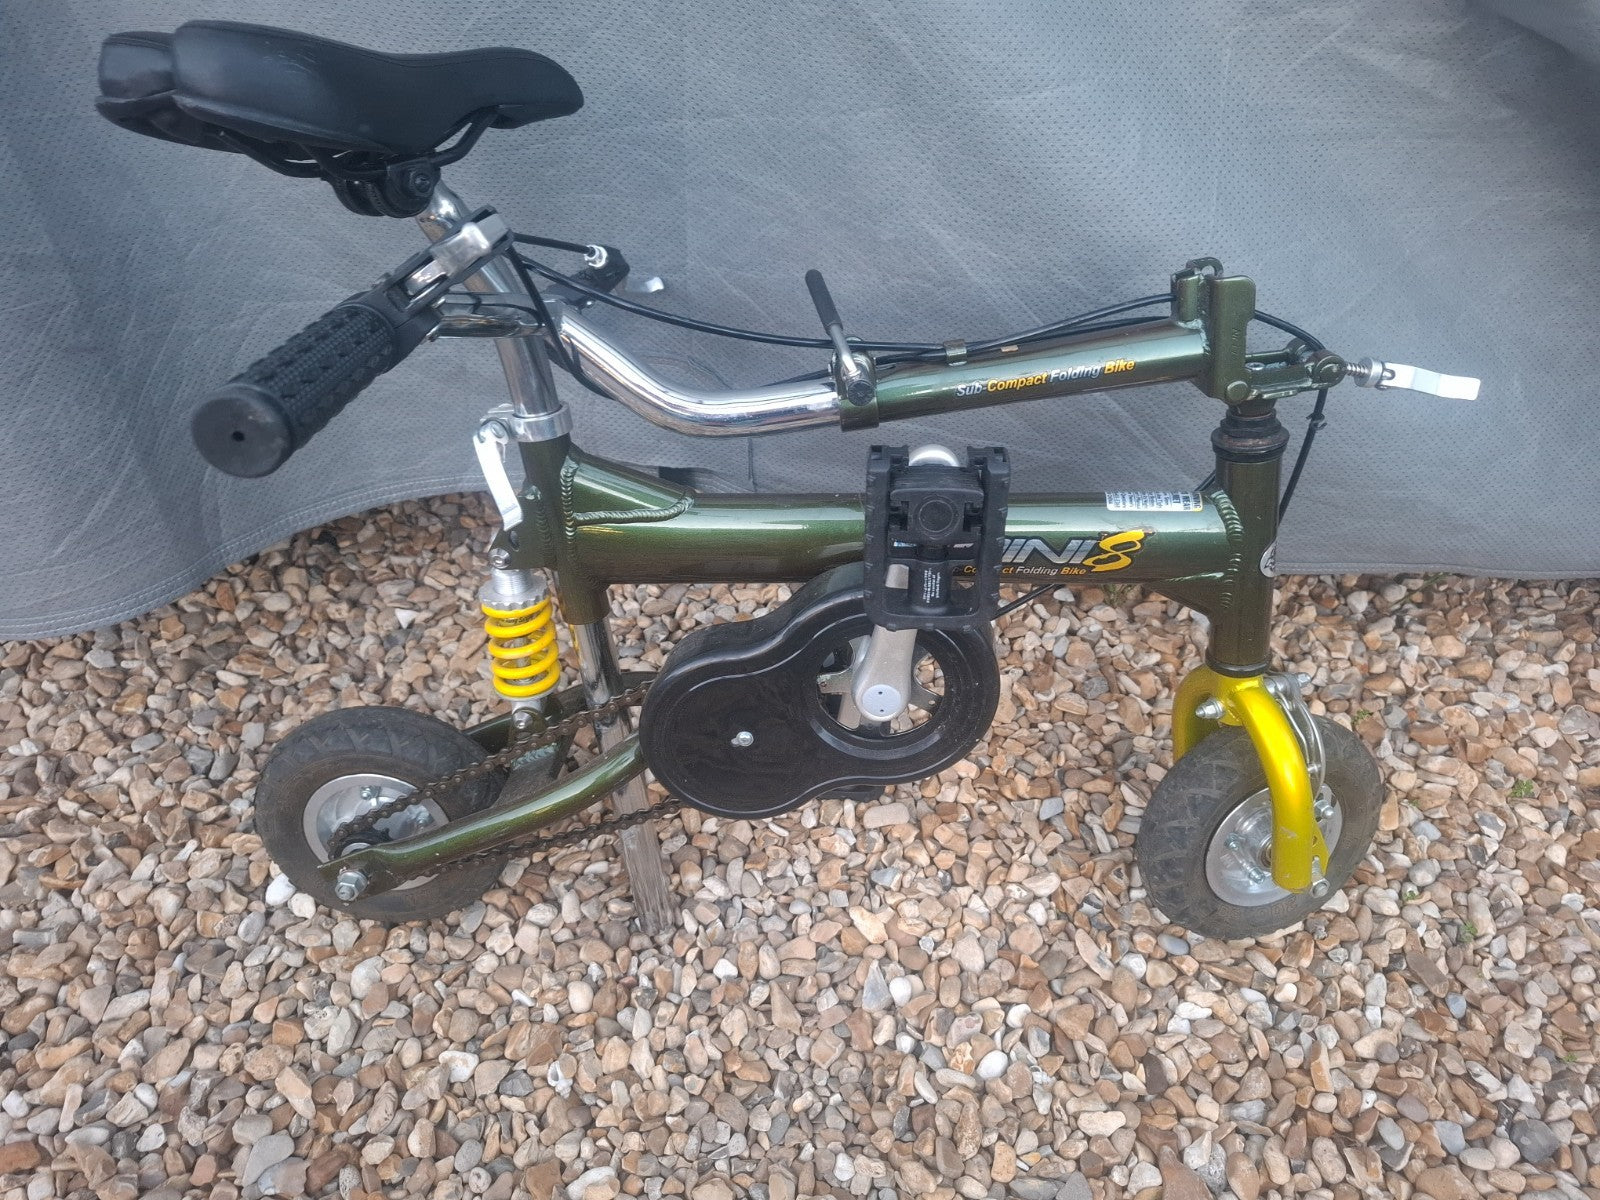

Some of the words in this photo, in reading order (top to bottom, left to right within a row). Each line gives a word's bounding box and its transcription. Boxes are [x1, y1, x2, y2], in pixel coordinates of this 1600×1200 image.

[956, 372, 1048, 397] Sub-Compact
[1050, 364, 1102, 383] Folding
[1103, 358, 1137, 374] Bike
[1015, 565, 1058, 576] Folding
[1060, 566, 1087, 575] Bike
